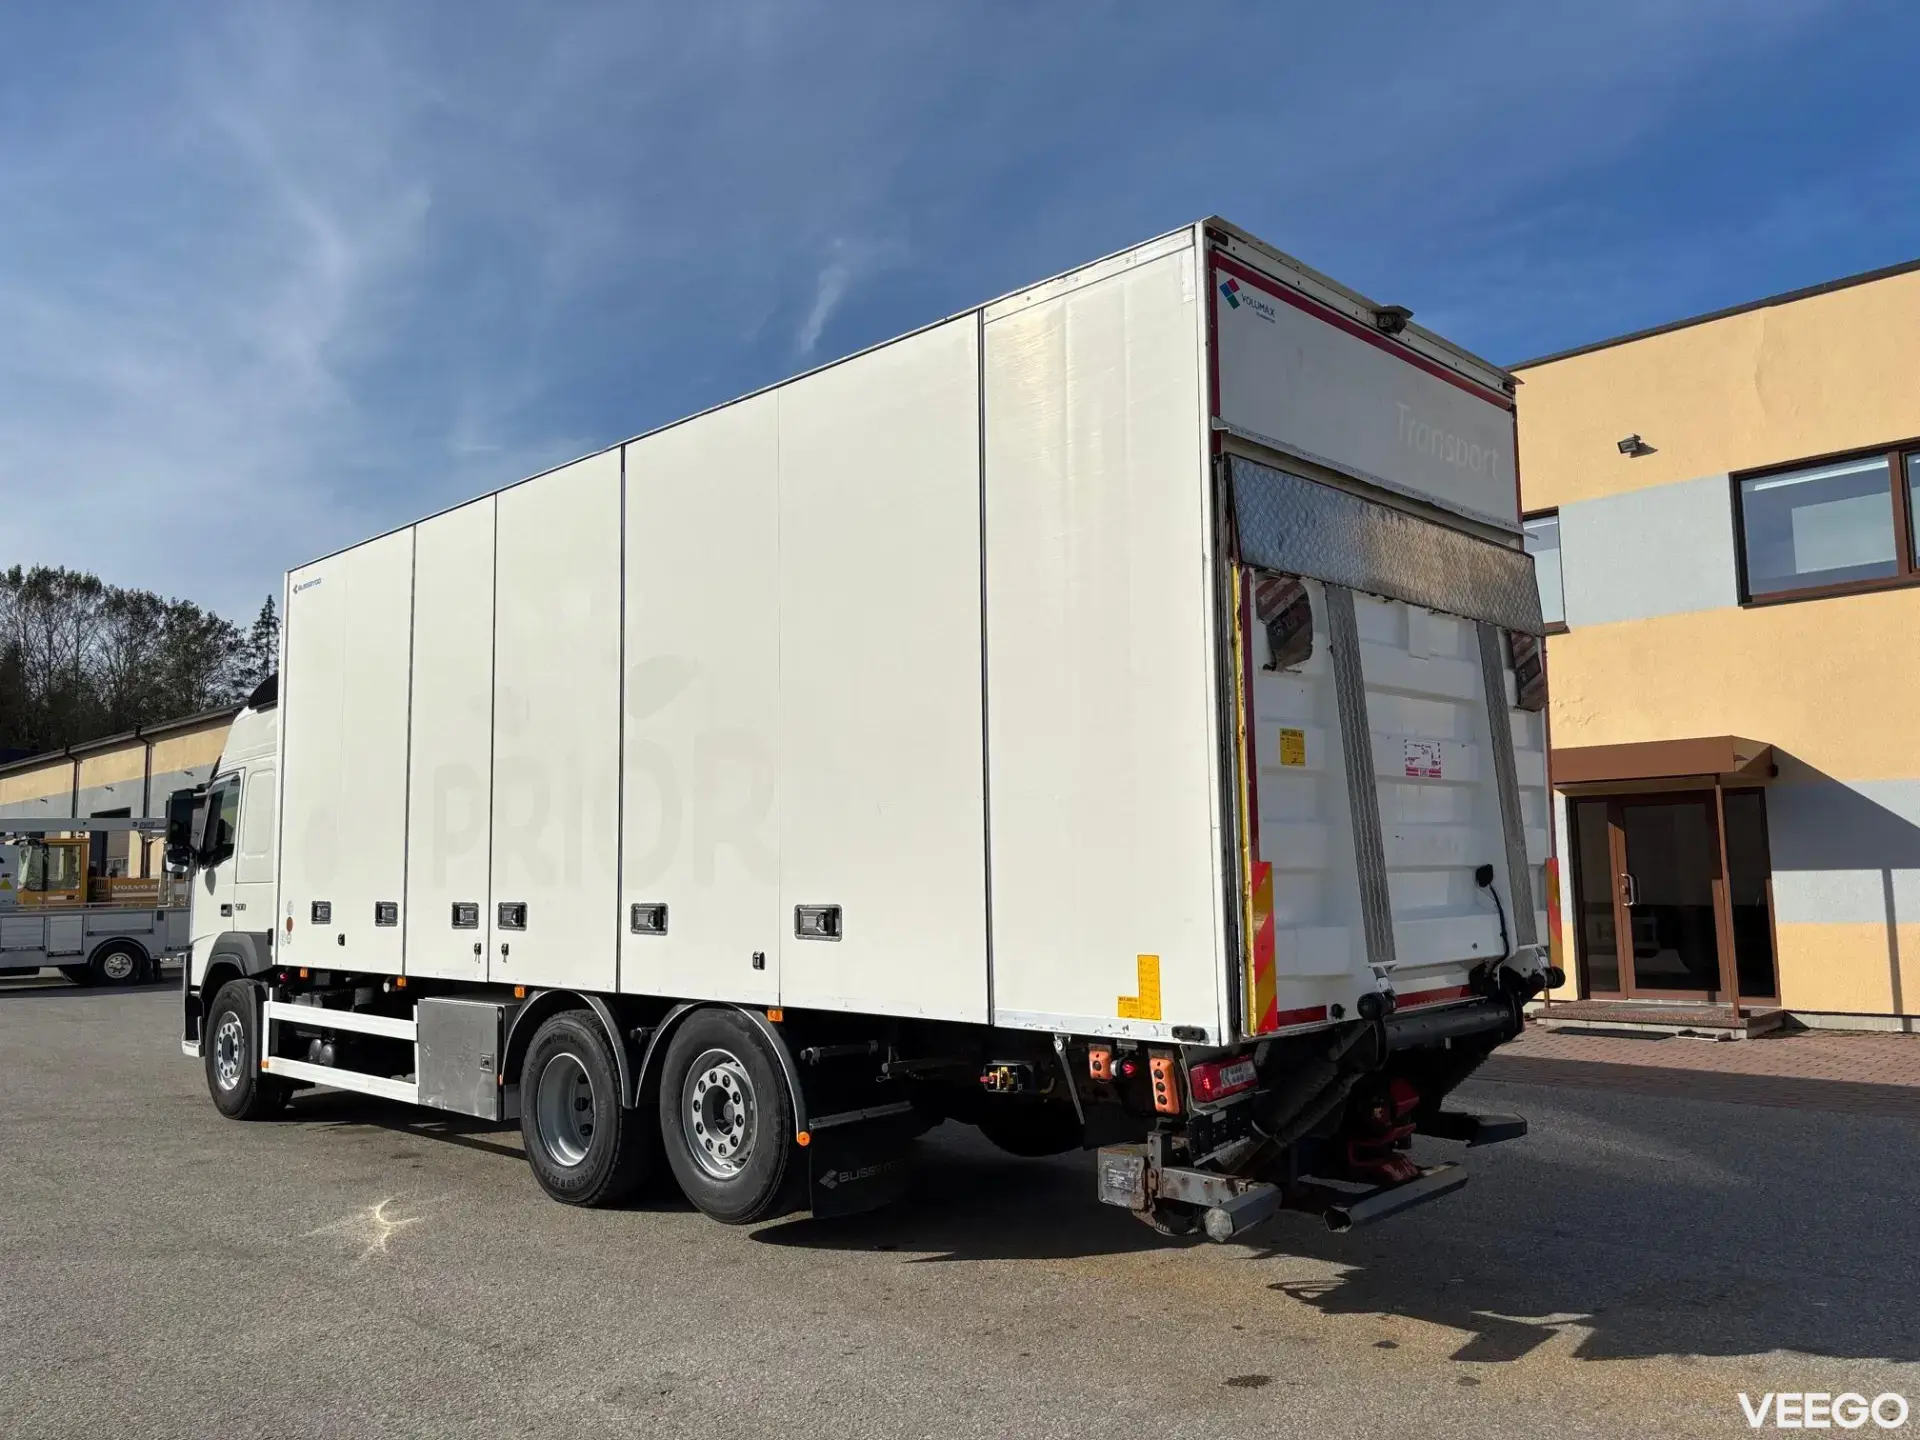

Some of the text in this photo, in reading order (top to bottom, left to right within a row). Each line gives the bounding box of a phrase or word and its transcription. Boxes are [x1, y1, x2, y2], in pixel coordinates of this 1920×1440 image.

[1241, 293, 1275, 317] VOLUMAX
[1397, 402, 1499, 481] Transport
[433, 730, 780, 888] PRIOR
